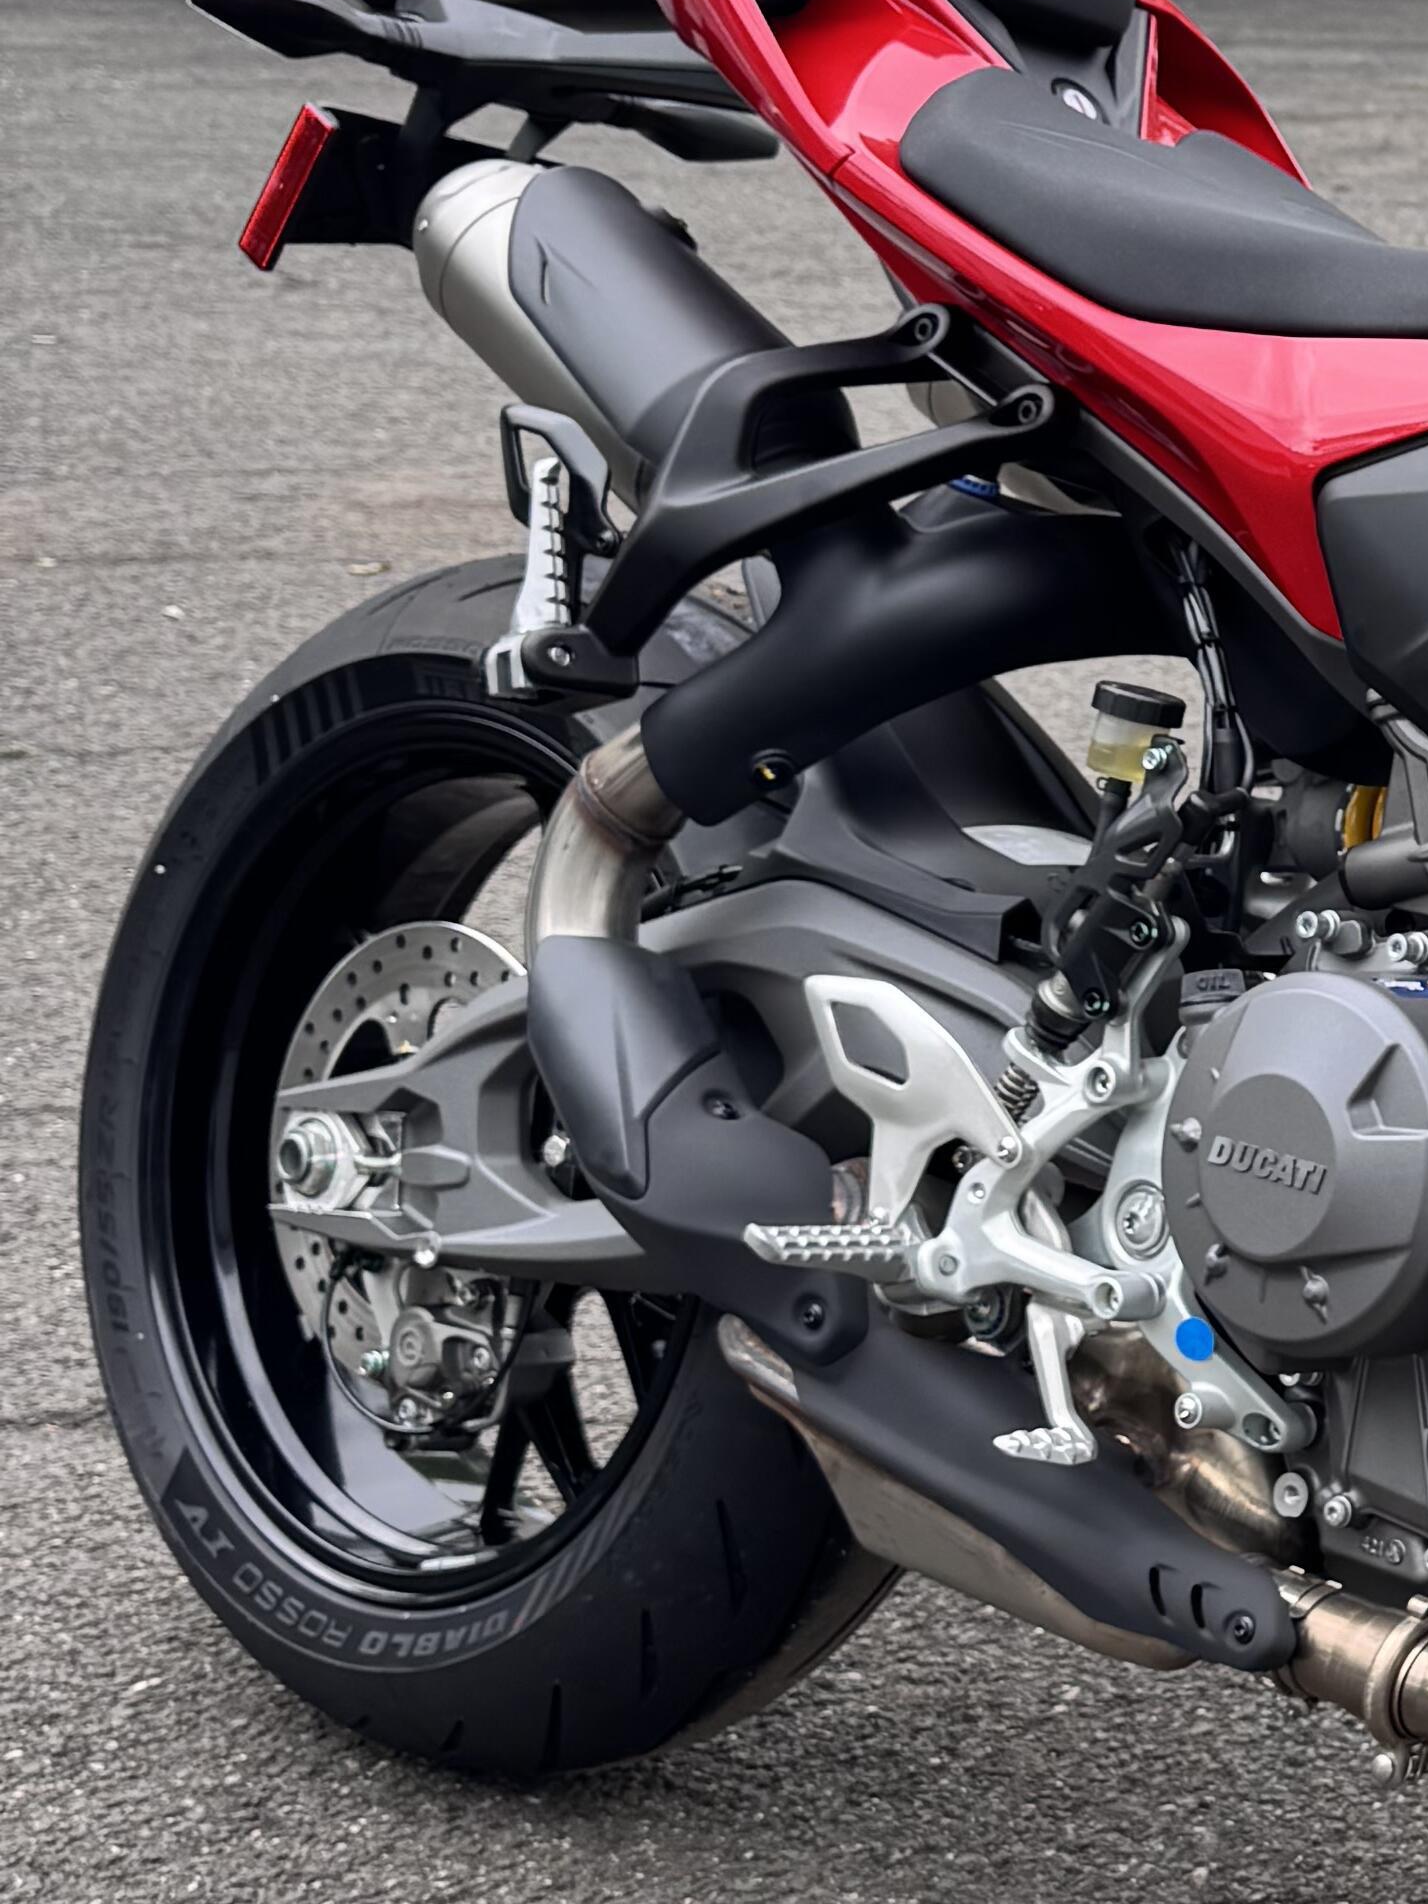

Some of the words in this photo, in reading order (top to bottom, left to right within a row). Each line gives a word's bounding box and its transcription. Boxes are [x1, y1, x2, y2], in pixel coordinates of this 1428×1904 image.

[1207, 1135, 1329, 1196] DUCATI
[174, 1499, 235, 1559] IV
[232, 1562, 353, 1649] ROSSO
[358, 1609, 511, 1658] DIABLO
